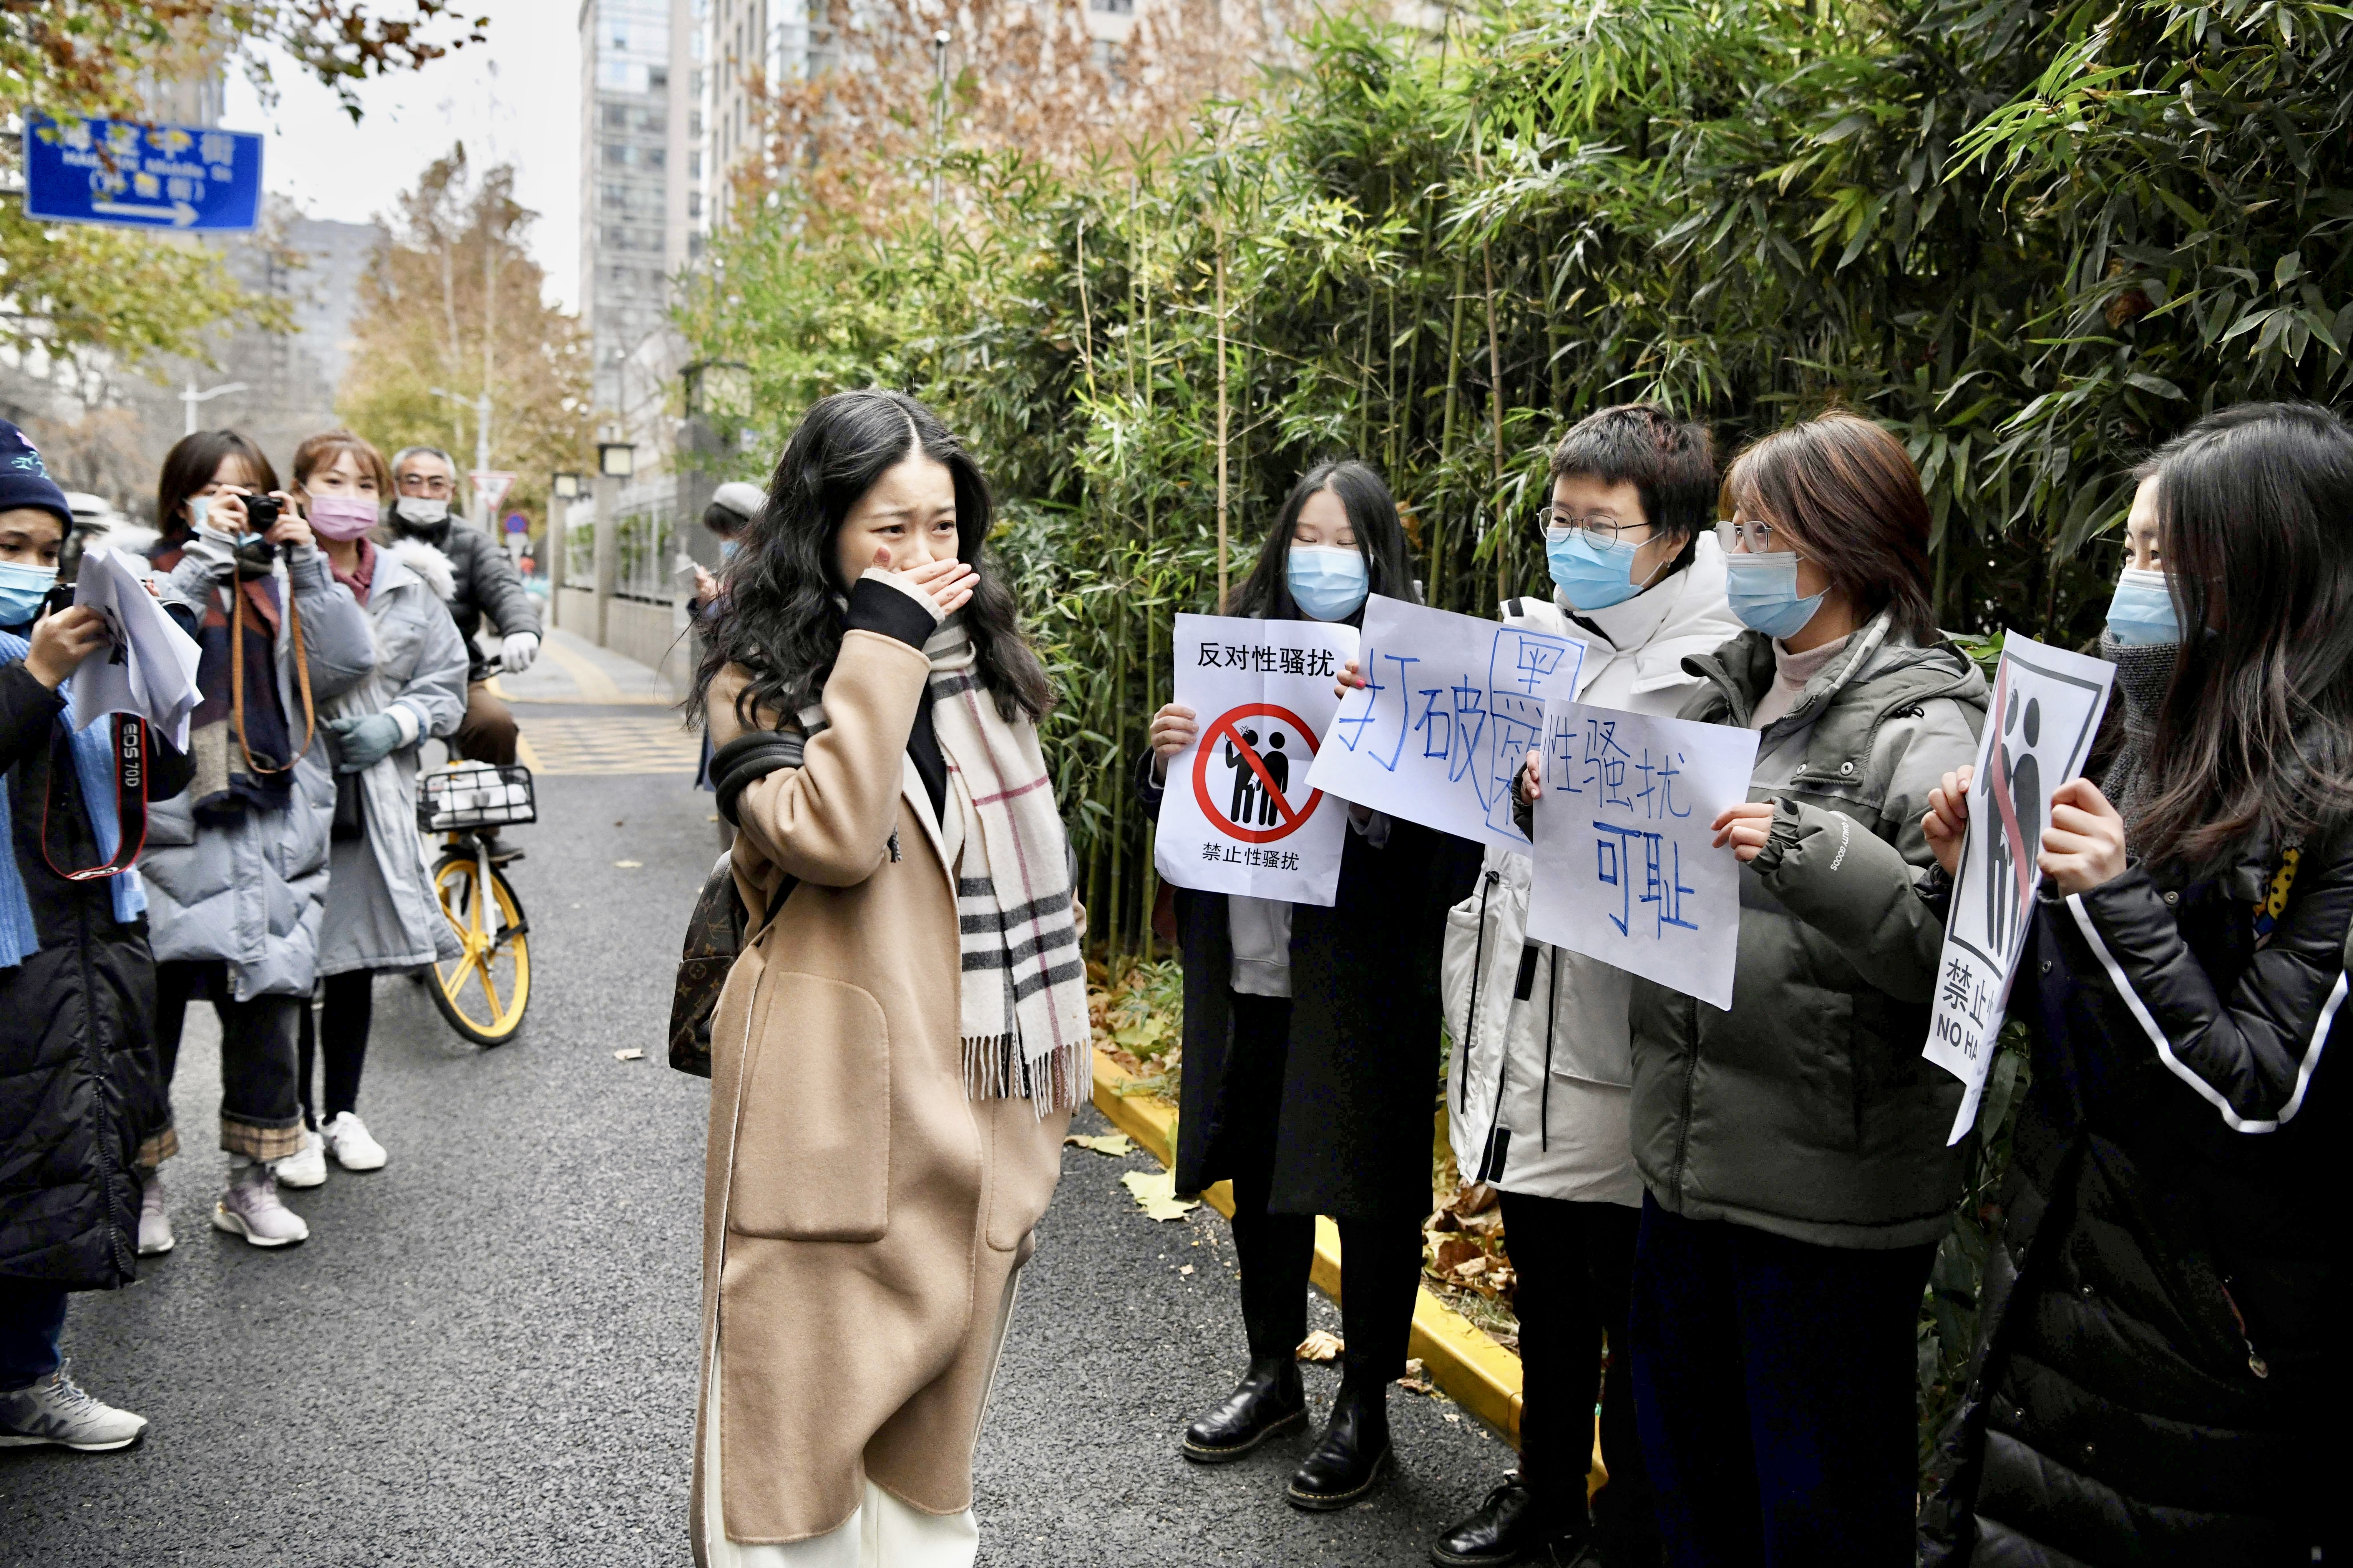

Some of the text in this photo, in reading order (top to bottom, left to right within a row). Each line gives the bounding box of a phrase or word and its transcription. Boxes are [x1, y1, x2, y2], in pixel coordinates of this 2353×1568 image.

[1198, 642, 1335, 677] 反对性骚扰
[123, 723, 140, 787] EOS 70D
[1543, 714, 1691, 819] 性骚扰
[1202, 842, 1299, 871] 禁止性骚扰
[1830, 822, 1849, 871] QUALITY GOODS
[1593, 820, 1698, 940] 可耻
[1942, 958, 1994, 1031] 禁止
[1936, 1013, 1962, 1047] NO
